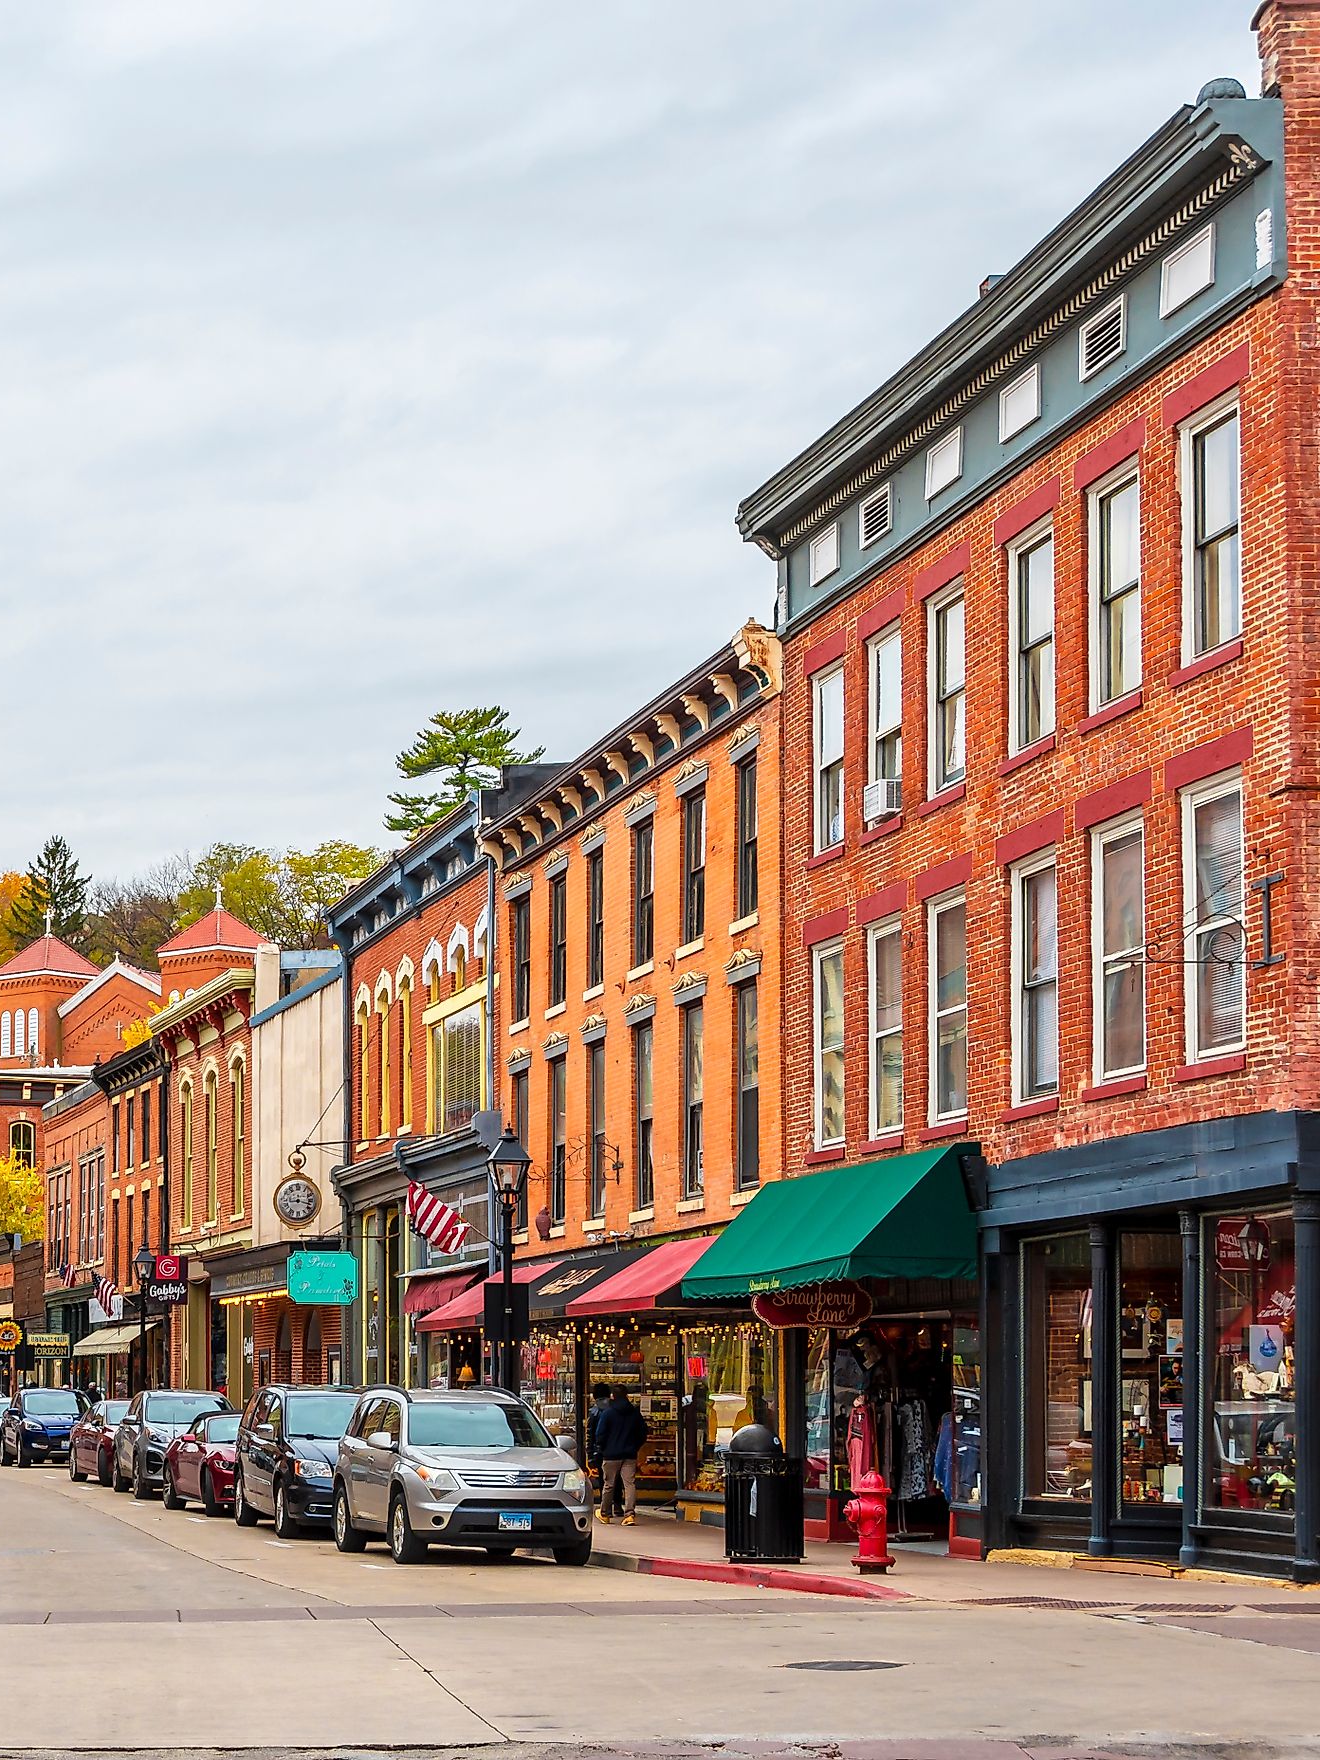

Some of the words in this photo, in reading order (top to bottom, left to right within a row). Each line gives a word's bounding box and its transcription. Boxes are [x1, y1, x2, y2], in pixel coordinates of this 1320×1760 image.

[149, 1282, 187, 1301] Gabby's
[772, 1286, 856, 1316] Strawberry
[807, 1303, 848, 1323] Lane
